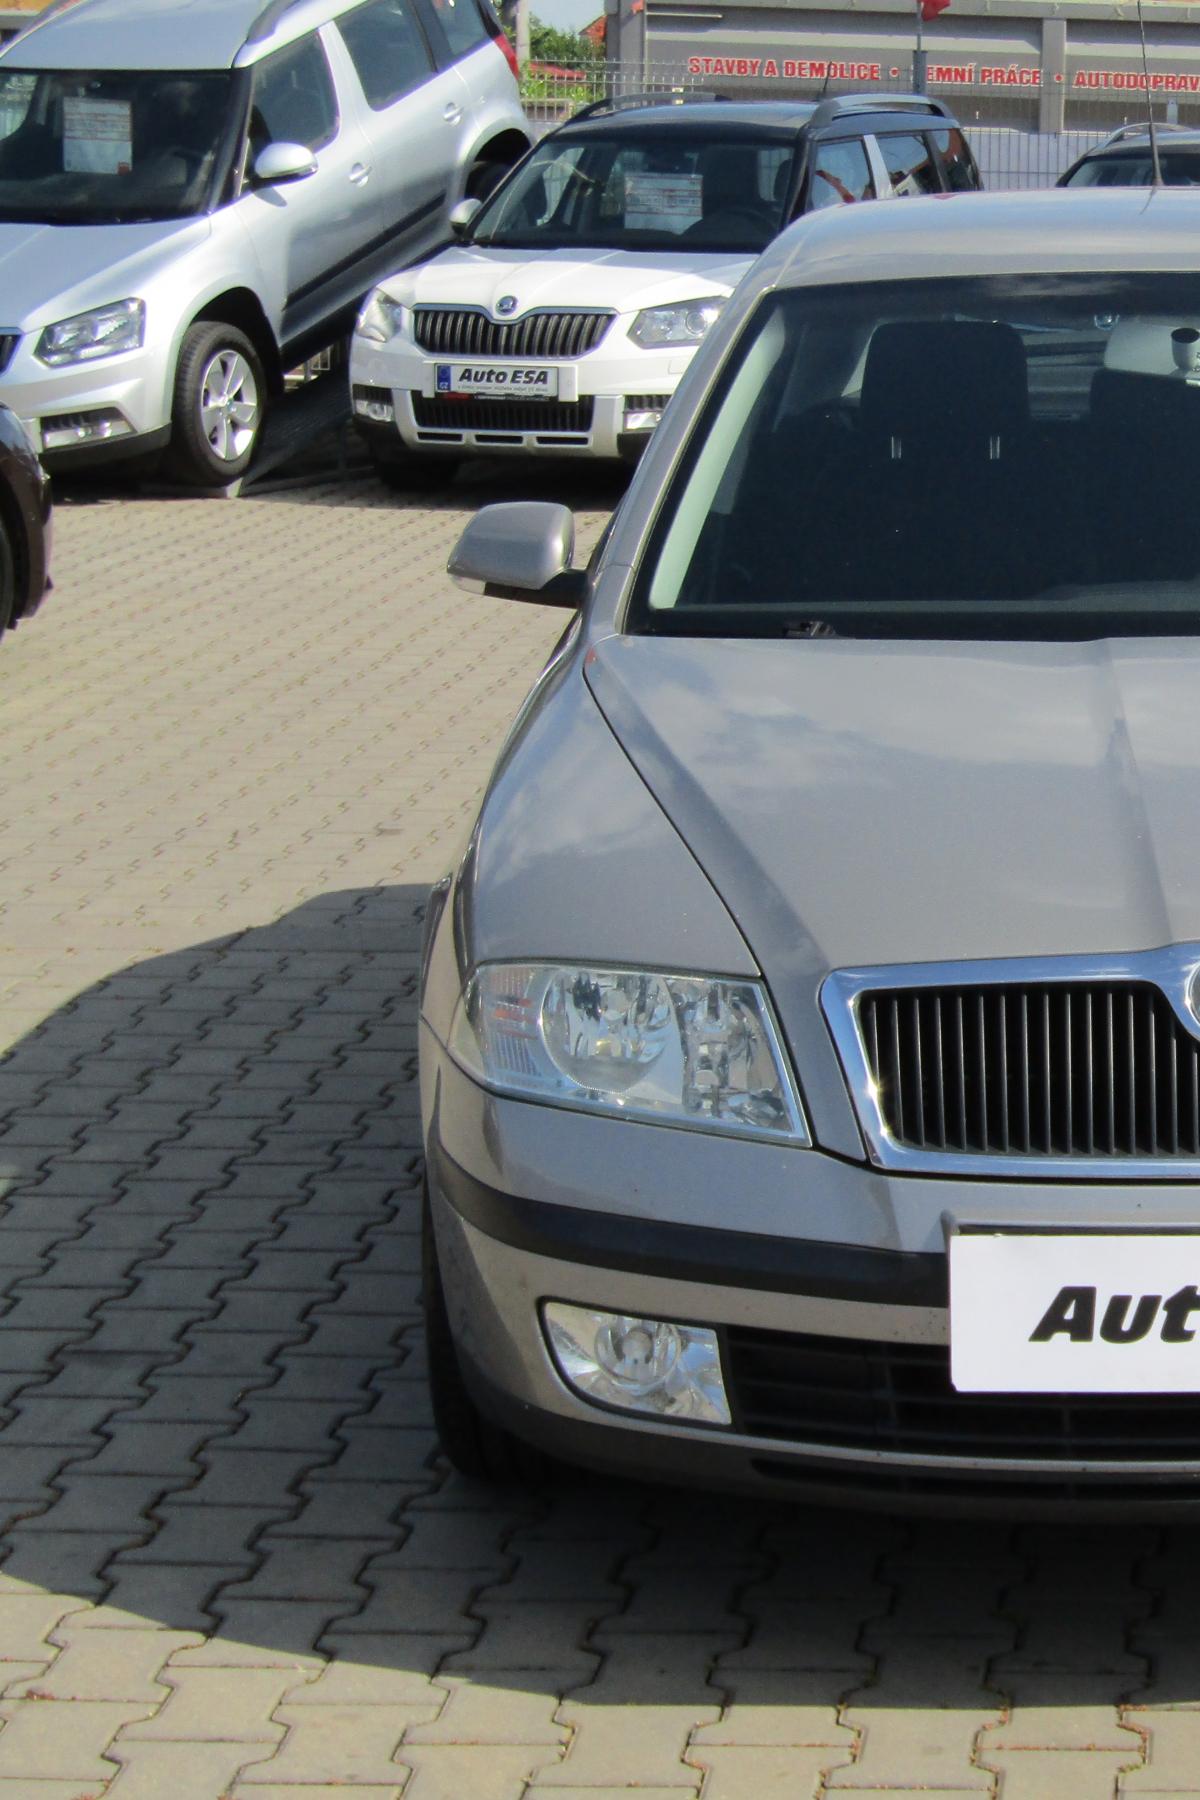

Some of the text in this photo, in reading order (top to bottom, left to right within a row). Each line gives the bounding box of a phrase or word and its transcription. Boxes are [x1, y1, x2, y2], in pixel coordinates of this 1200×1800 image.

[688, 56, 762, 77] STAVBY
[764, 59, 779, 77] A
[784, 60, 882, 81] DEMOLICE
[911, 63, 976, 84] EMNÍ
[979, 64, 1043, 87] PRÁCE
[459, 368, 548, 385] Auto ESA
